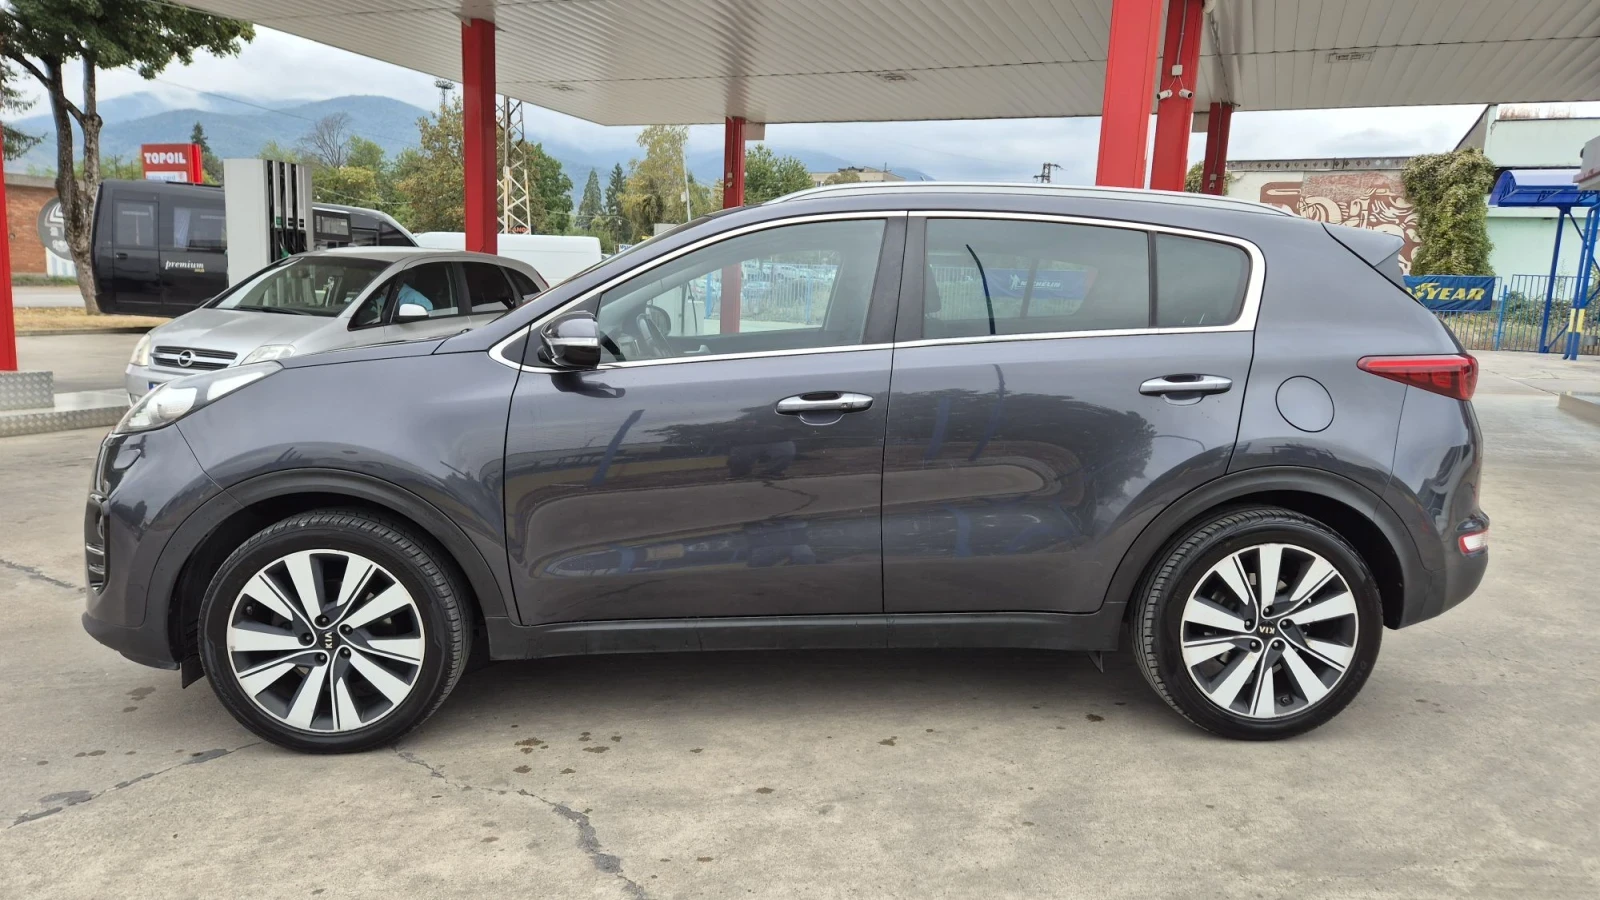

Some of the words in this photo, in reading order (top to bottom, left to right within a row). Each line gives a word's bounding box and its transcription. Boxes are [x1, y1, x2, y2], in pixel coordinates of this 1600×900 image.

[144, 152, 187, 164] TOPOIL
[165, 260, 204, 270] premium
[1259, 625, 1276, 635] KIA
[324, 631, 333, 649] KIA
